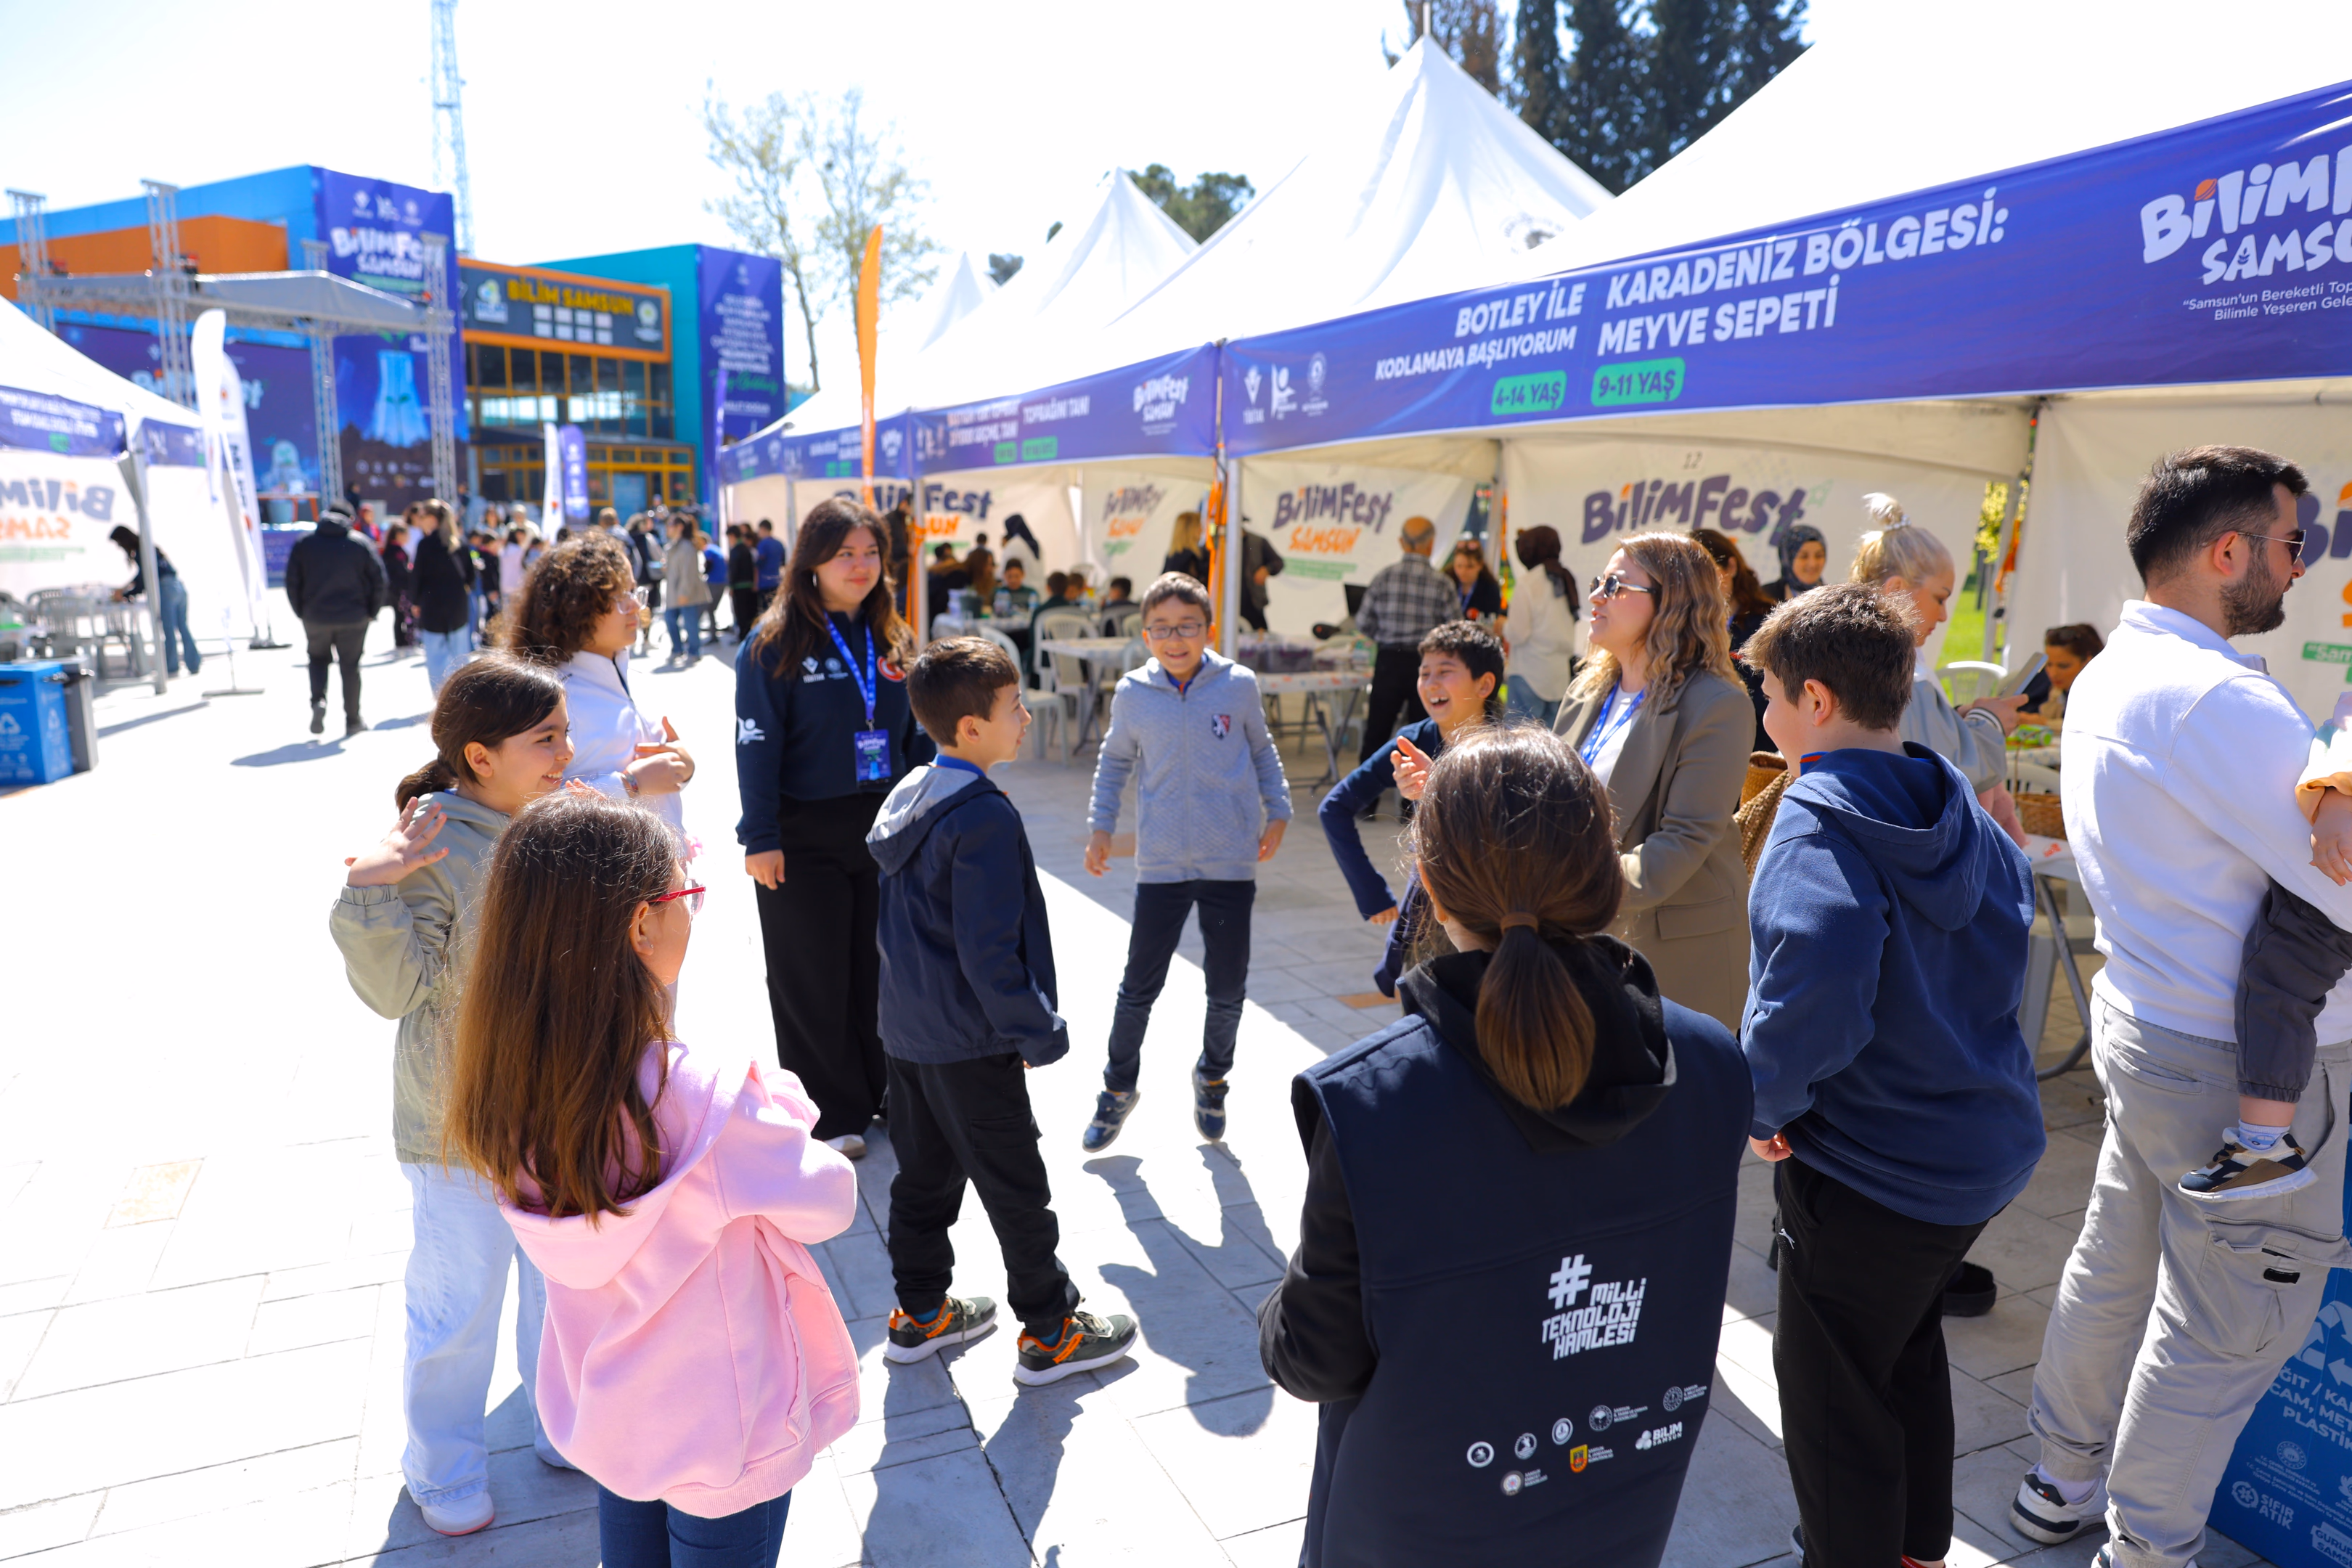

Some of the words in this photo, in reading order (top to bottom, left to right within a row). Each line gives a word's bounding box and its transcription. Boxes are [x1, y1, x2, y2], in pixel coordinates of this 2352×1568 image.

[1606, 235, 1799, 310] KARADENİZ
[1804, 187, 2009, 276] BÖLGESİ:
[563, 287, 634, 315] SAMSUN
[2261, 282, 2324, 302] Bereketli
[1455, 290, 1546, 338] BOTLEY
[1545, 279, 1587, 321] İLE
[1597, 306, 1710, 356] MEYVE
[1713, 274, 1840, 342] SEPETİ
[2214, 306, 2259, 321] Bilimle
[2263, 300, 2317, 316] Yeşeren
[1375, 346, 1464, 380] KODLAMAYA
[1466, 326, 1577, 369] BAŞLIYORUM
[1495, 386, 1526, 407] 4-14
[1531, 381, 1561, 409] YAŞ
[1598, 372, 1633, 398] 9-11
[1638, 369, 1676, 401] YAŞ
[1542, 1299, 1642, 1344] TEKNOLOJİ
[1553, 1321, 1637, 1361] HAMLESİ
[2279, 1366, 2310, 1389] ĞIT
[1652, 1421, 1683, 1440] BİLİM
[1652, 1432, 1683, 1447] SAMSUN
[2259, 1505, 2292, 1531] ATIK
[2261, 1494, 2294, 1520] SIFIR
